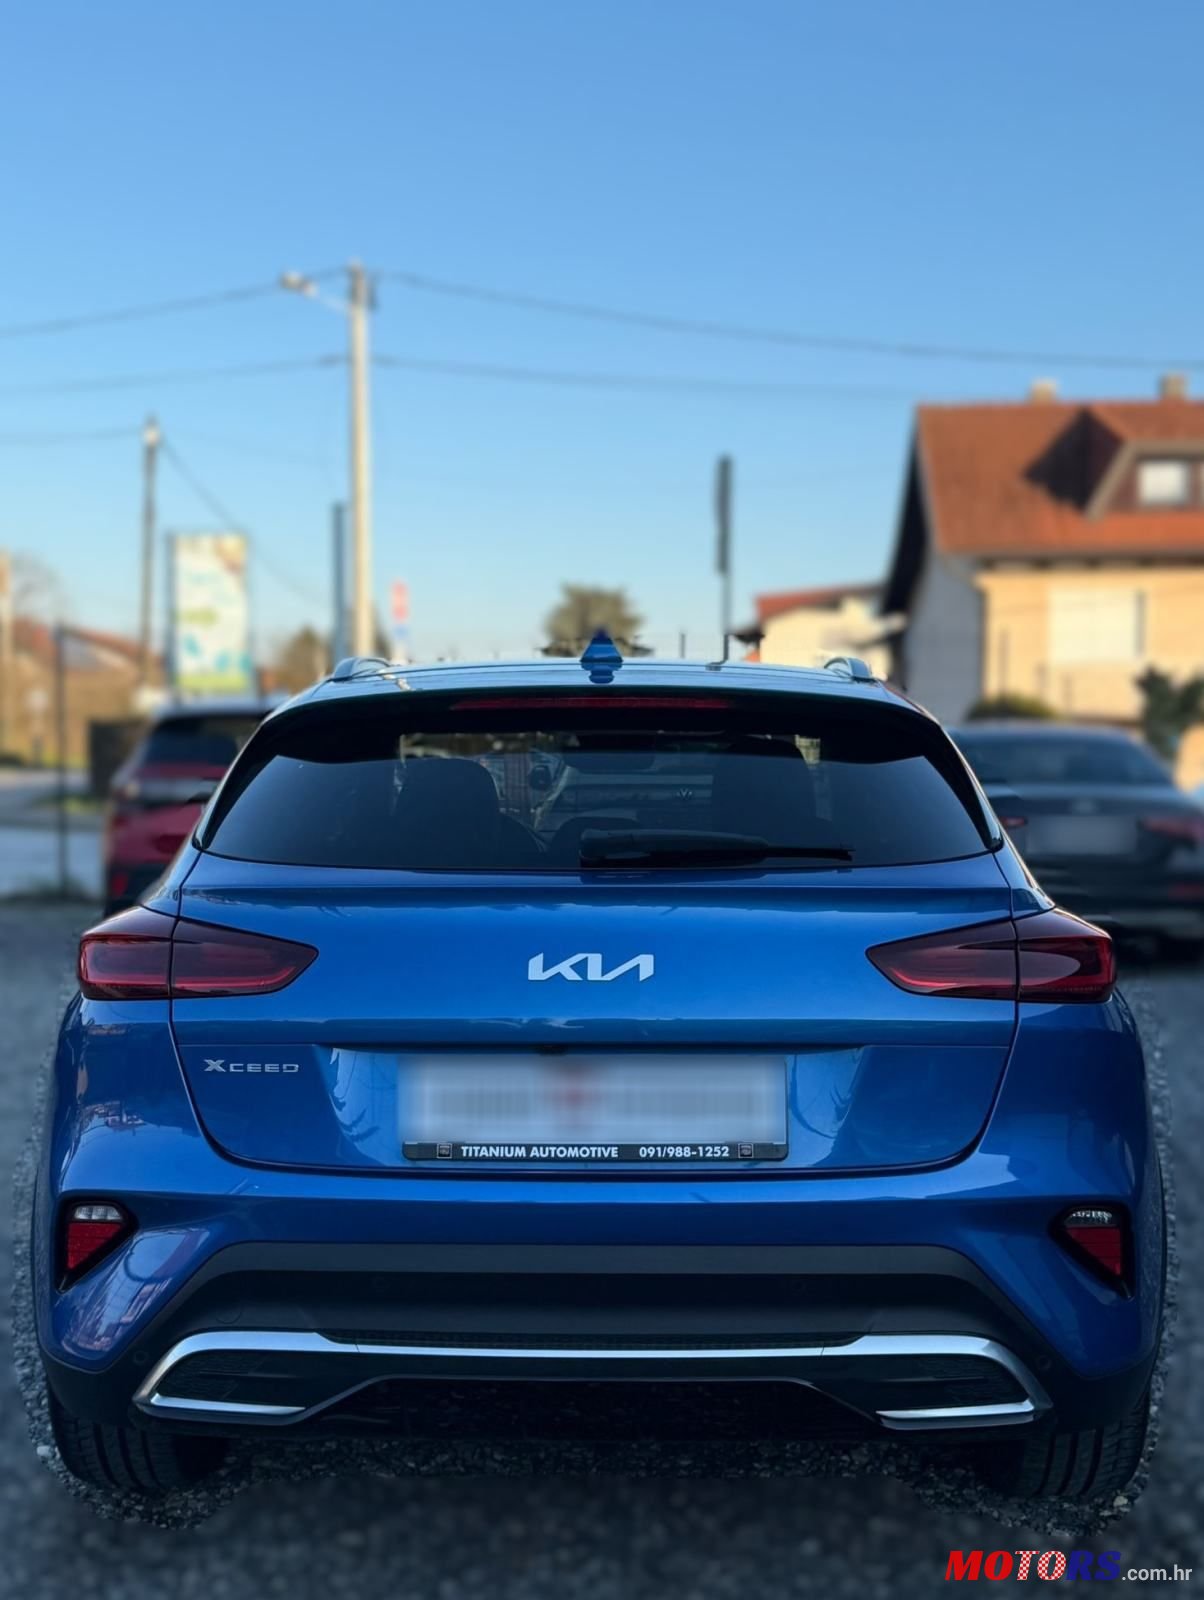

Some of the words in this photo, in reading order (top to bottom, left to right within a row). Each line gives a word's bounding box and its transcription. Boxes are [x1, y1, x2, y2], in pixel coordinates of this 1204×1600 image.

[461, 1145, 526, 1159] TITANIUM
[529, 1145, 619, 1159] AUTOMOTIVE
[638, 1144, 731, 1159] 091/988-1252
